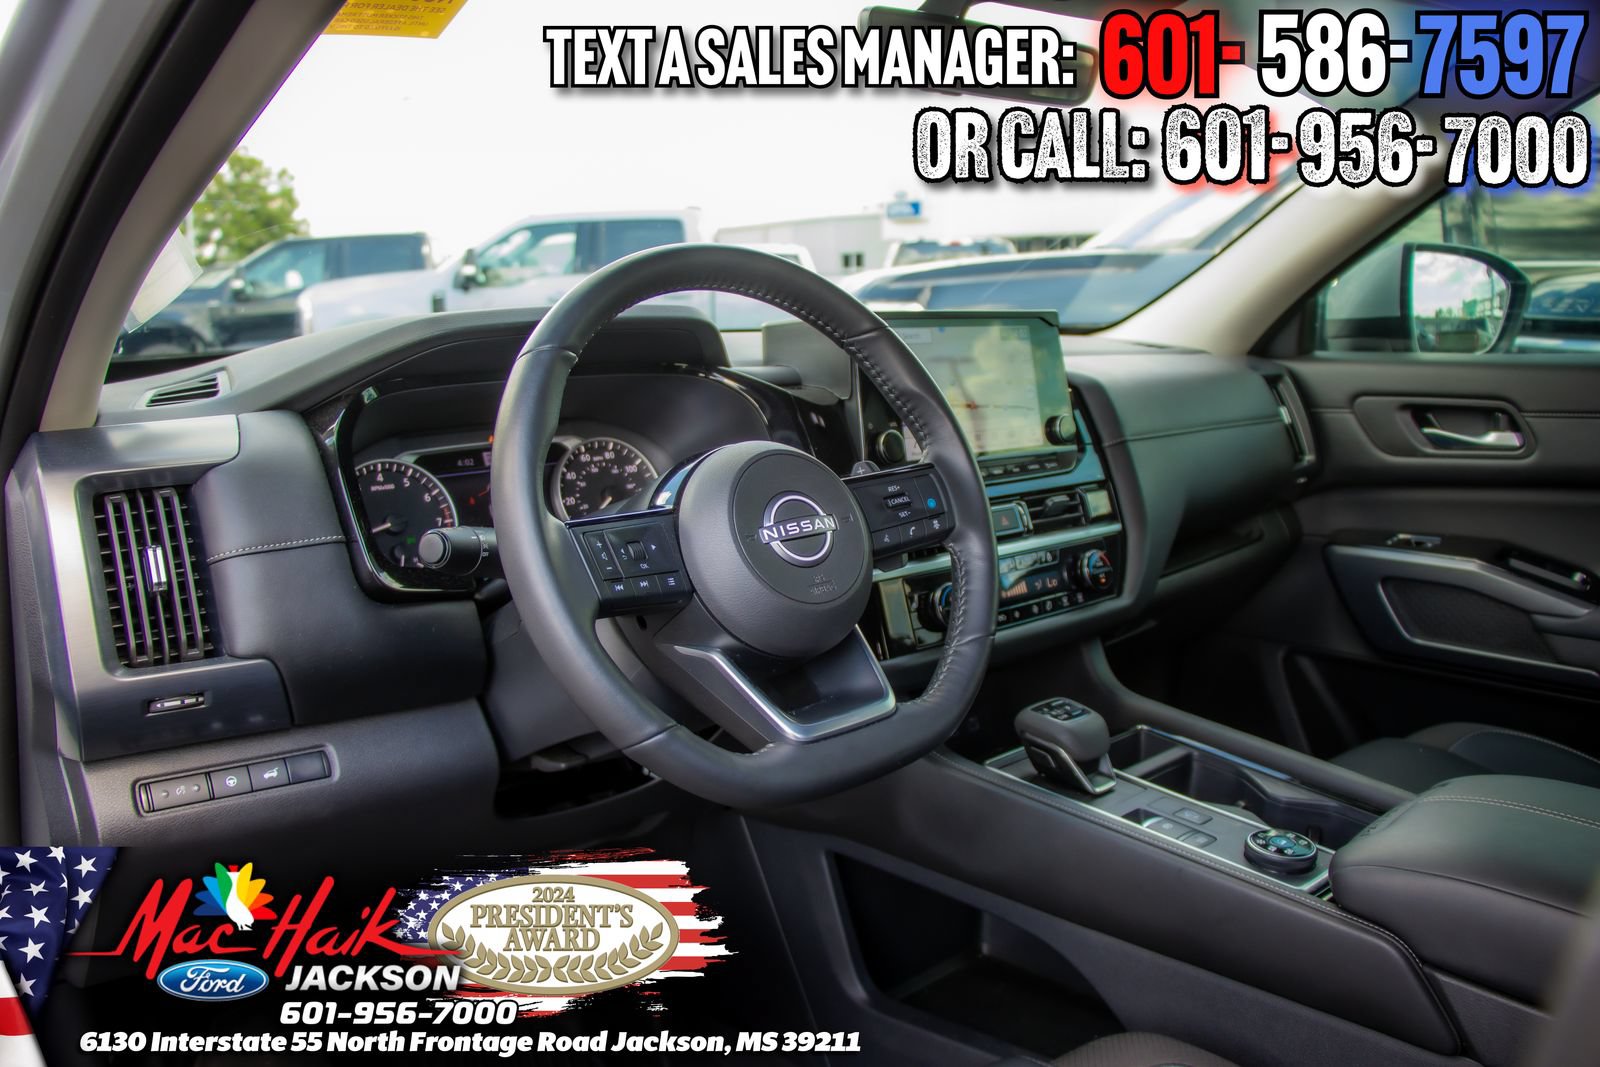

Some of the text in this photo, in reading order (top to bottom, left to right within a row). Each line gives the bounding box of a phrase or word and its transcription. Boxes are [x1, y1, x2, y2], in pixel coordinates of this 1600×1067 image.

[403, 478, 410, 487] 5
[424, 493, 431, 502] 6
[762, 517, 836, 540] NISSAN
